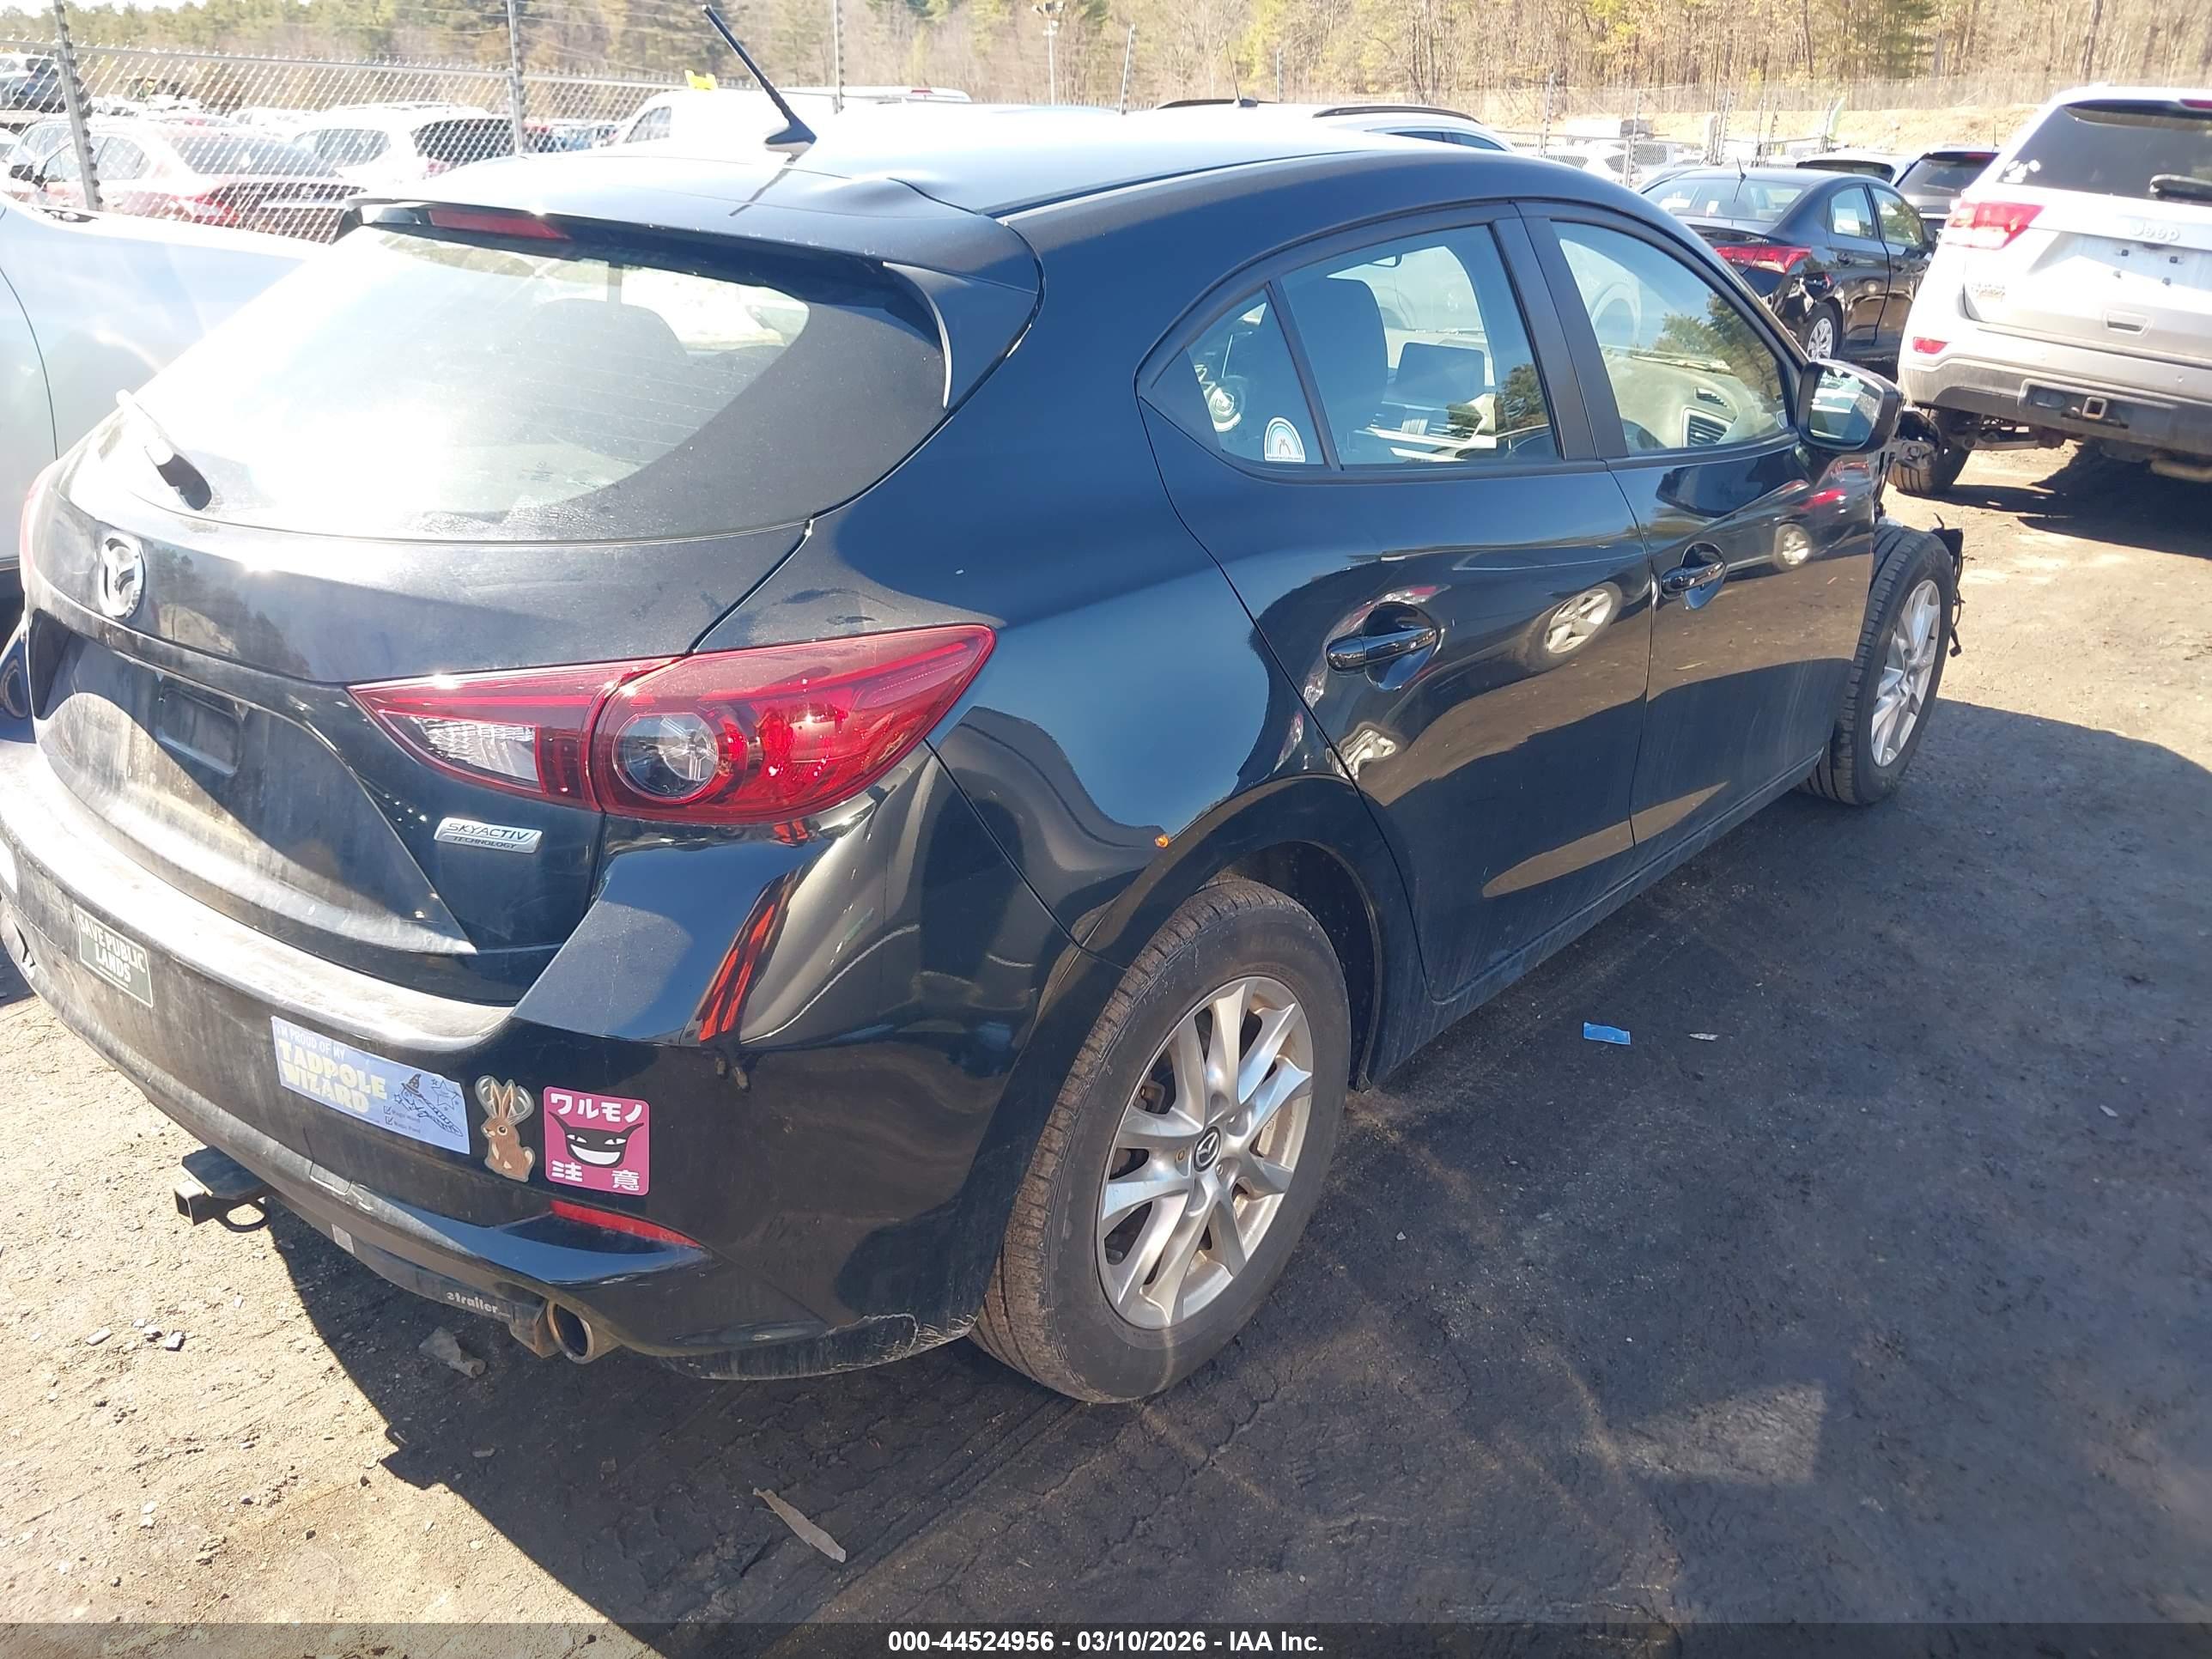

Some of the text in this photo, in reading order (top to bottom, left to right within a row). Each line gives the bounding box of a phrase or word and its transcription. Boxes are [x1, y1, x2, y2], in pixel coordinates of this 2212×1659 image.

[2130, 220, 2181, 244] Jeep
[447, 823, 529, 841] SKYACTIV
[453, 836, 517, 849] TECHNOLOGY
[78, 913, 146, 973] SAVE PUBLIC
[95, 942, 131, 983] LANDS
[291, 1030, 318, 1048] PROUD
[319, 1041, 331, 1055] OF
[332, 1042, 345, 1060] MY
[277, 1038, 387, 1100] TADPOLE
[280, 1059, 369, 1113] WIZARD
[550, 1092, 643, 1123] ワルモノ
